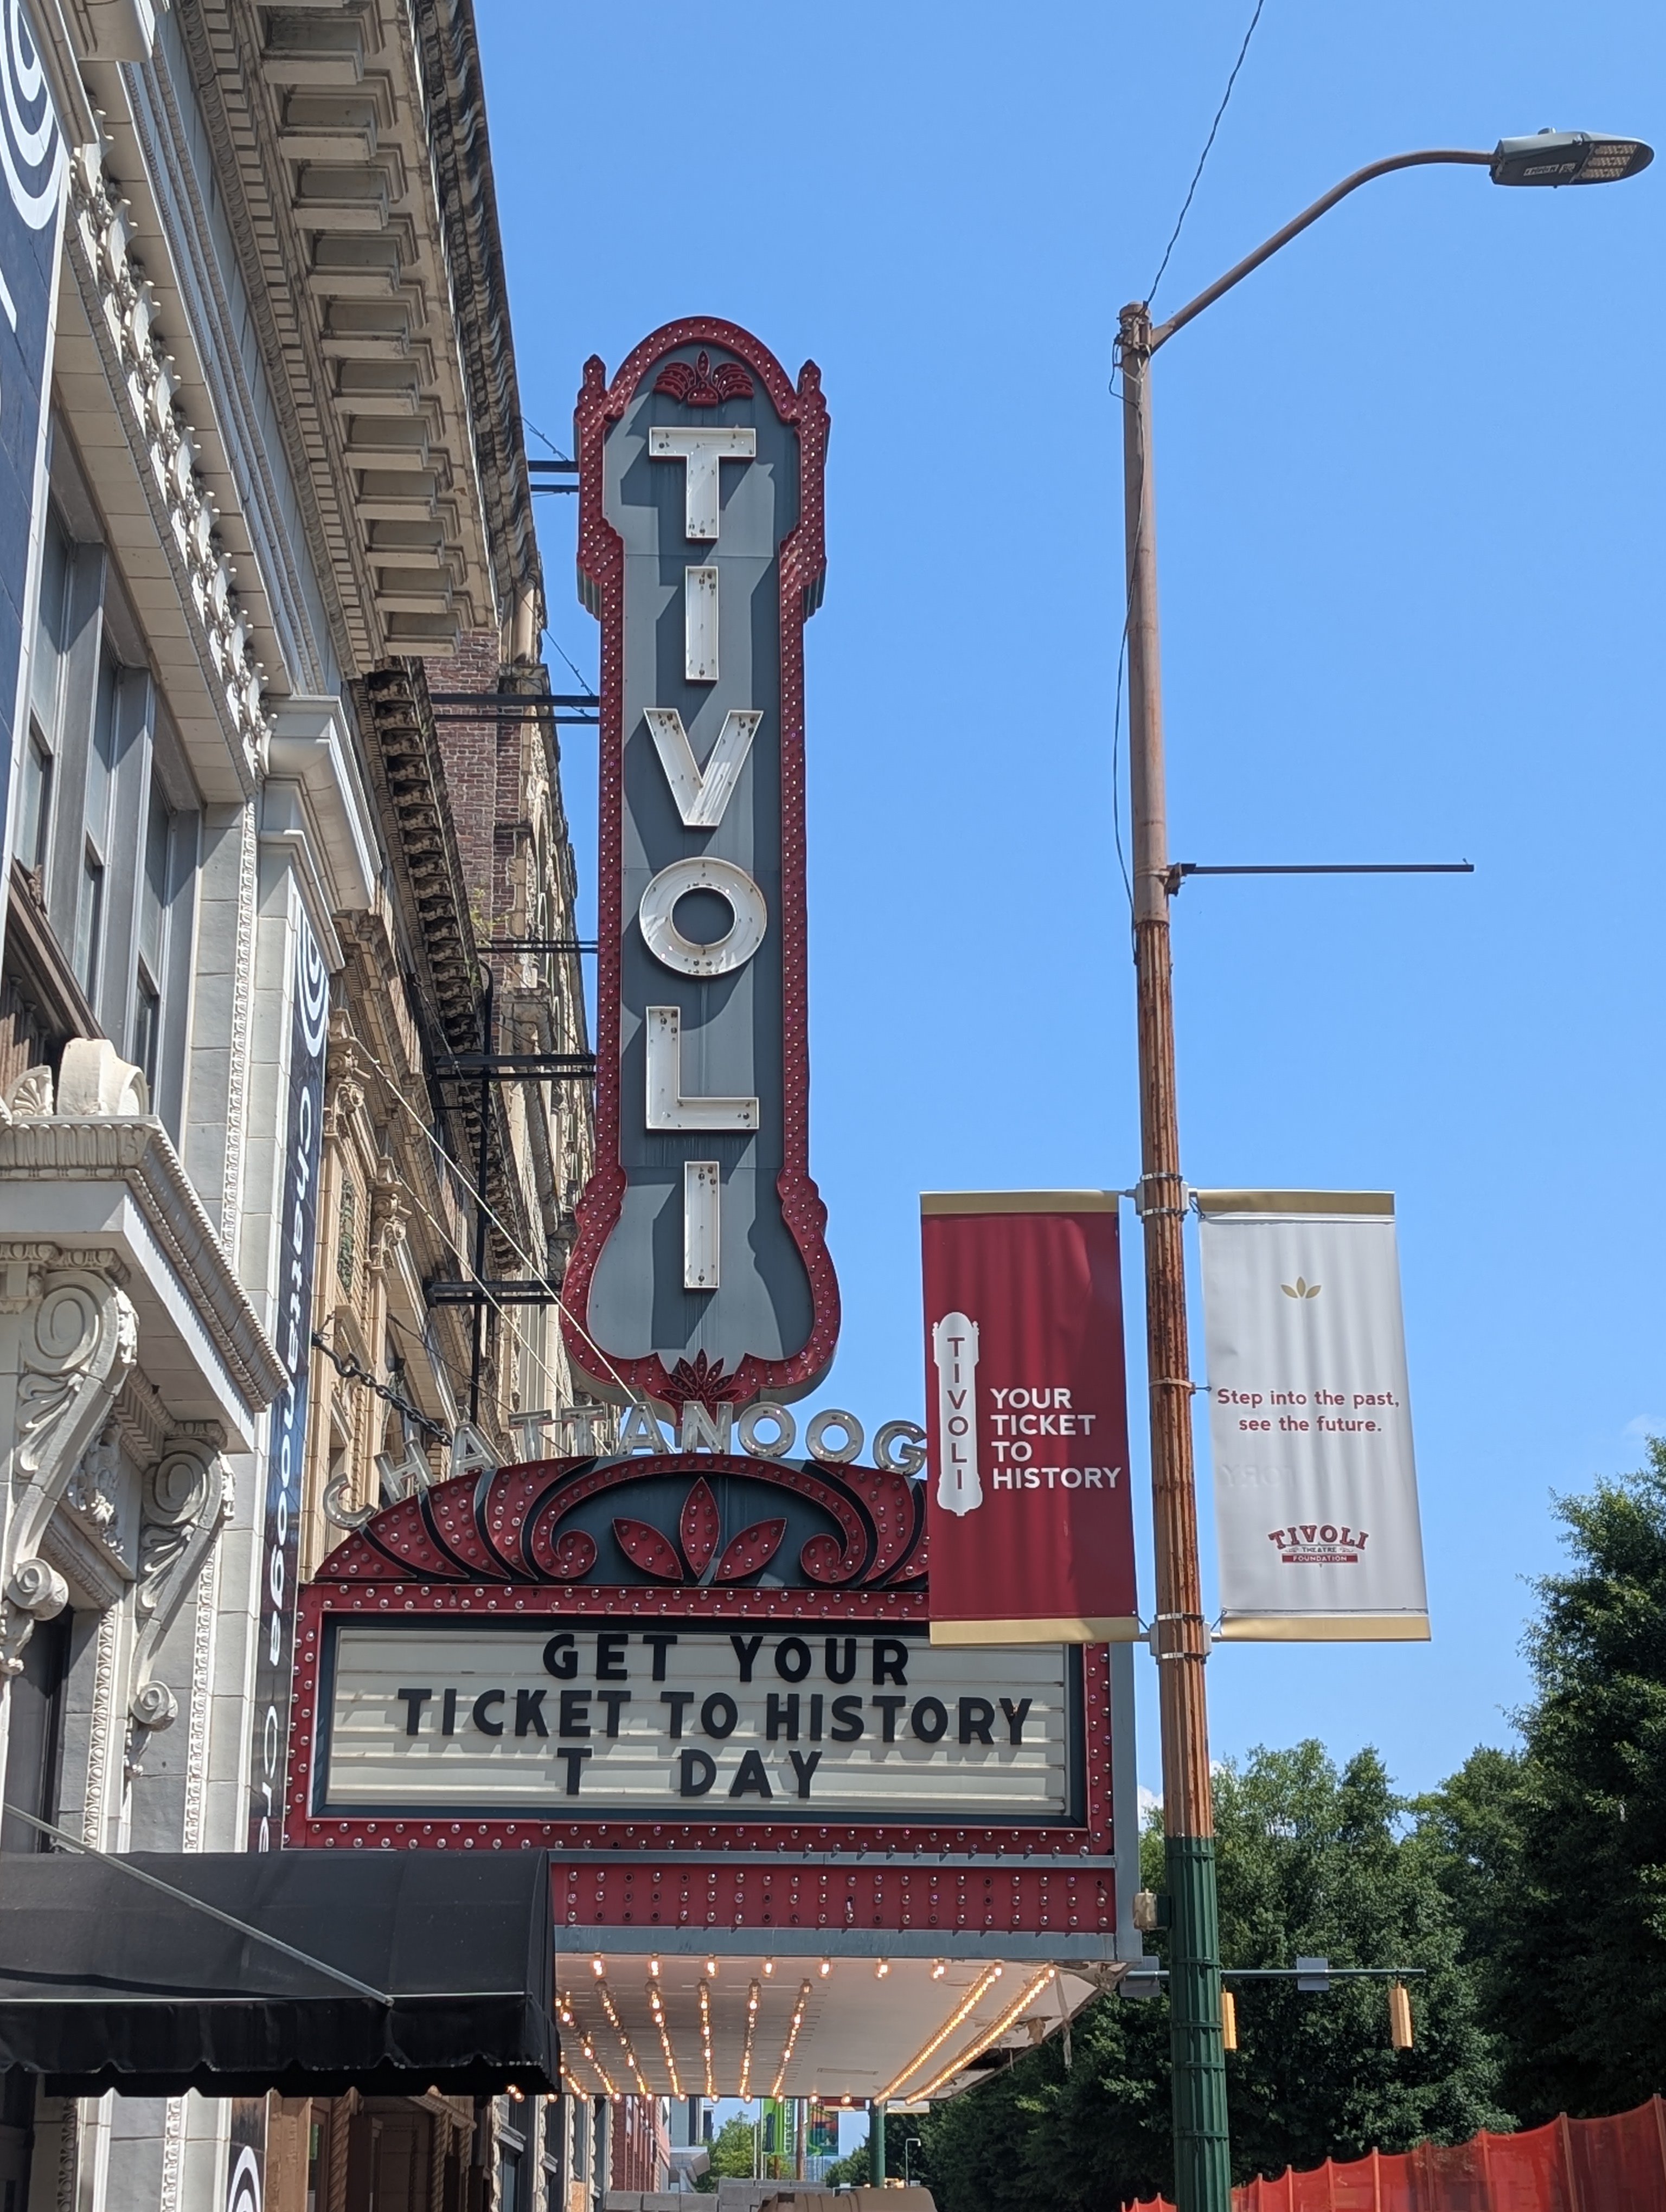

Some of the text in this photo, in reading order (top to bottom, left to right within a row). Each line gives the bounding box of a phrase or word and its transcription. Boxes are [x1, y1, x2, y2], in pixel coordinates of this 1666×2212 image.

[640, 427, 768, 1289] TIVOLI
[270, 1086, 311, 1666] Chattanooga
[990, 1387, 1073, 1409] YOUR
[1217, 1388, 1400, 1410] Step into the past,
[947, 1337, 969, 1490] TIVOLI
[990, 1414, 1096, 1436] TICKET
[1239, 1414, 1382, 1432] see the future.
[991, 1441, 1033, 1462] TO
[993, 1467, 1122, 1489] HISTORY
[1267, 1525, 1369, 1550] TIVOLI
[543, 1633, 909, 1686] GET YOUR
[398, 1688, 1033, 1745] TICKET TO HISTORY
[681, 1750, 823, 1799] DAY
